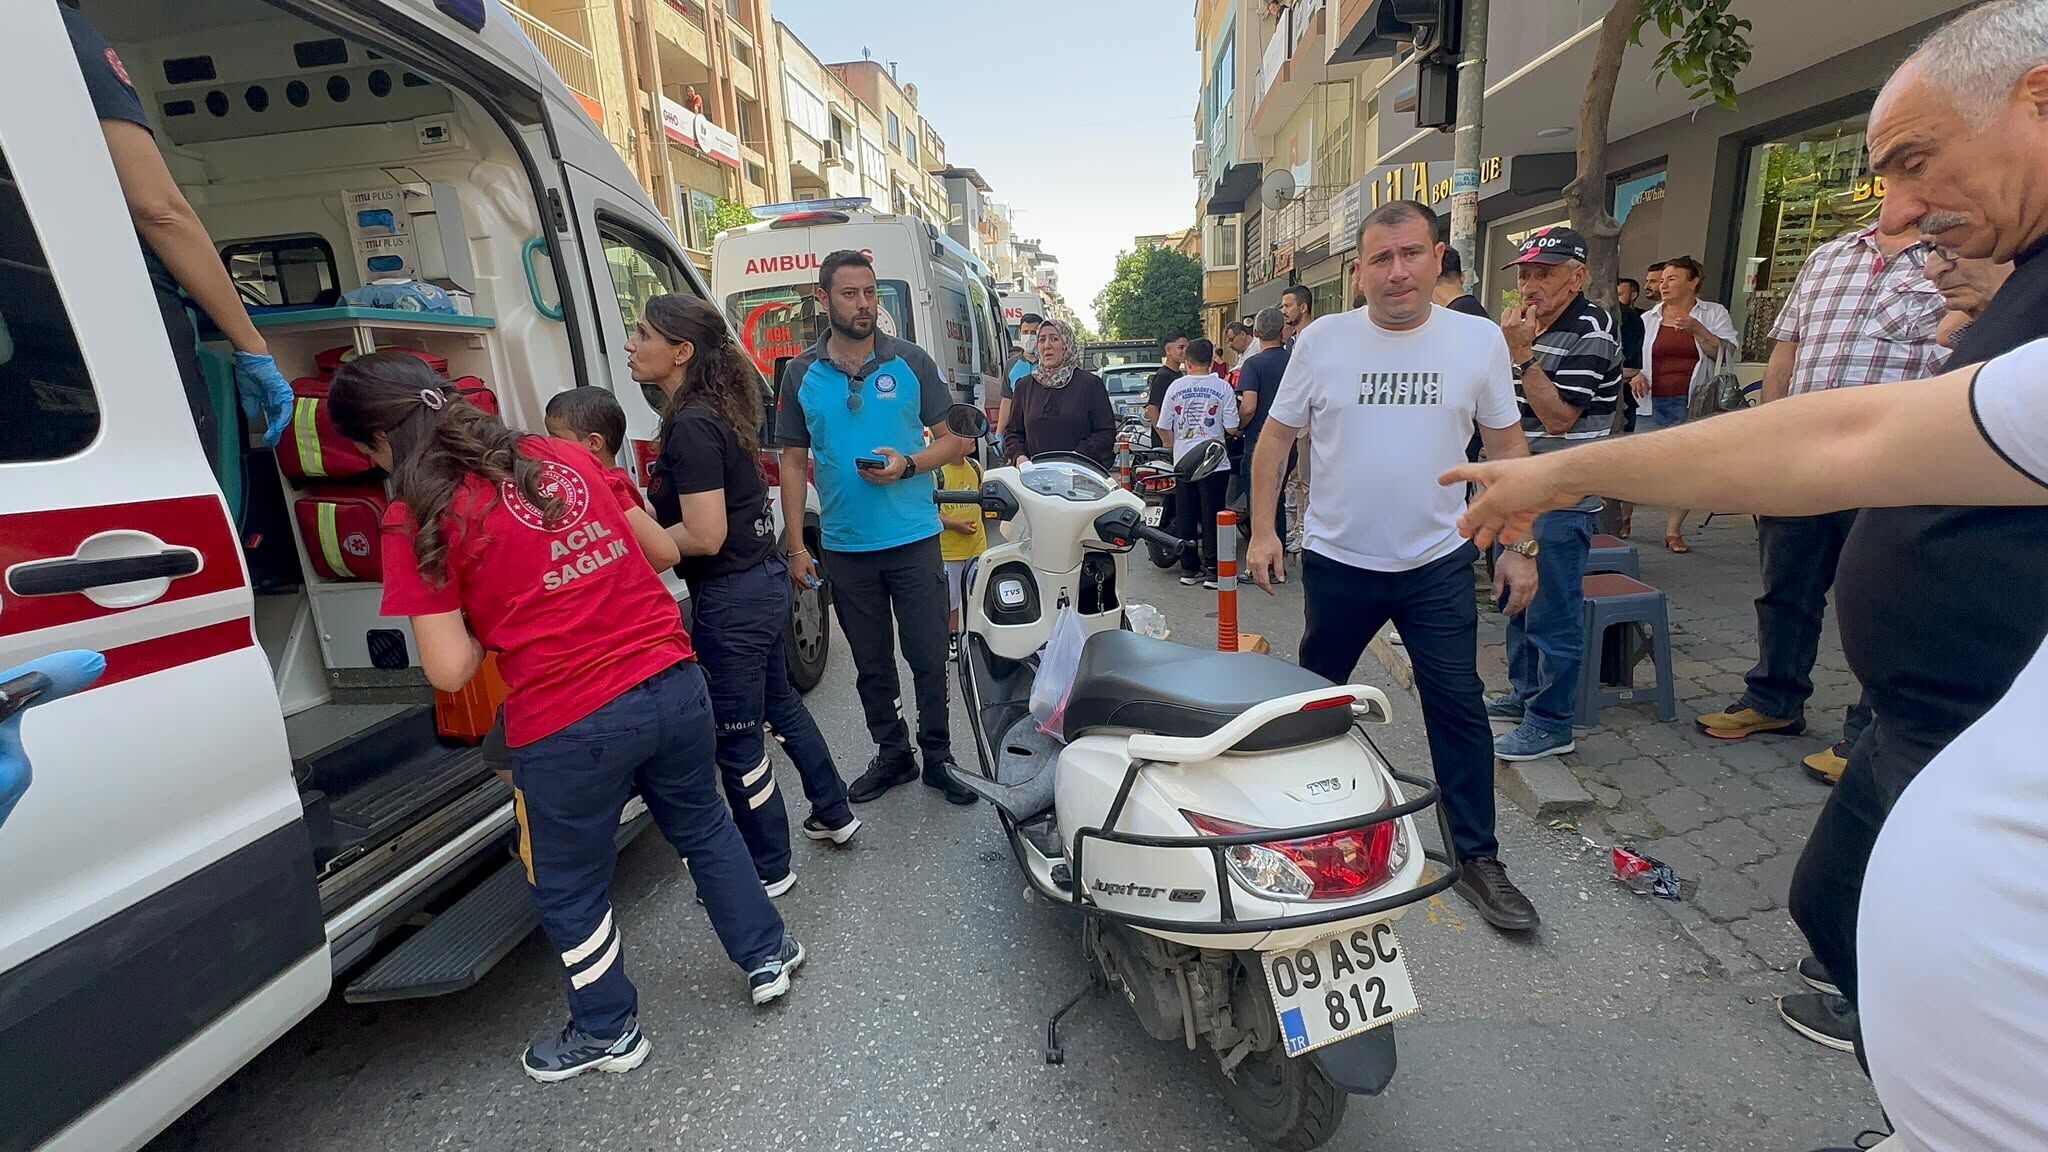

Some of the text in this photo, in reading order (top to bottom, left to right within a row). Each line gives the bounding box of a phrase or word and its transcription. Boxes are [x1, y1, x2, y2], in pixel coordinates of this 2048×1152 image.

[372, 191, 394, 201] PLUS
[745, 248, 874, 275] AMBULS
[1361, 382, 1438, 396] BASIC
[550, 520, 612, 562] ACİL
[542, 537, 630, 591] SAĞLIK
[1003, 588, 1021, 597] TVS
[1306, 776, 1342, 796] TVS
[1271, 923, 1398, 998] 09 ASC
[1324, 976, 1393, 1032] 812
[1289, 1035, 1307, 1050] TR
